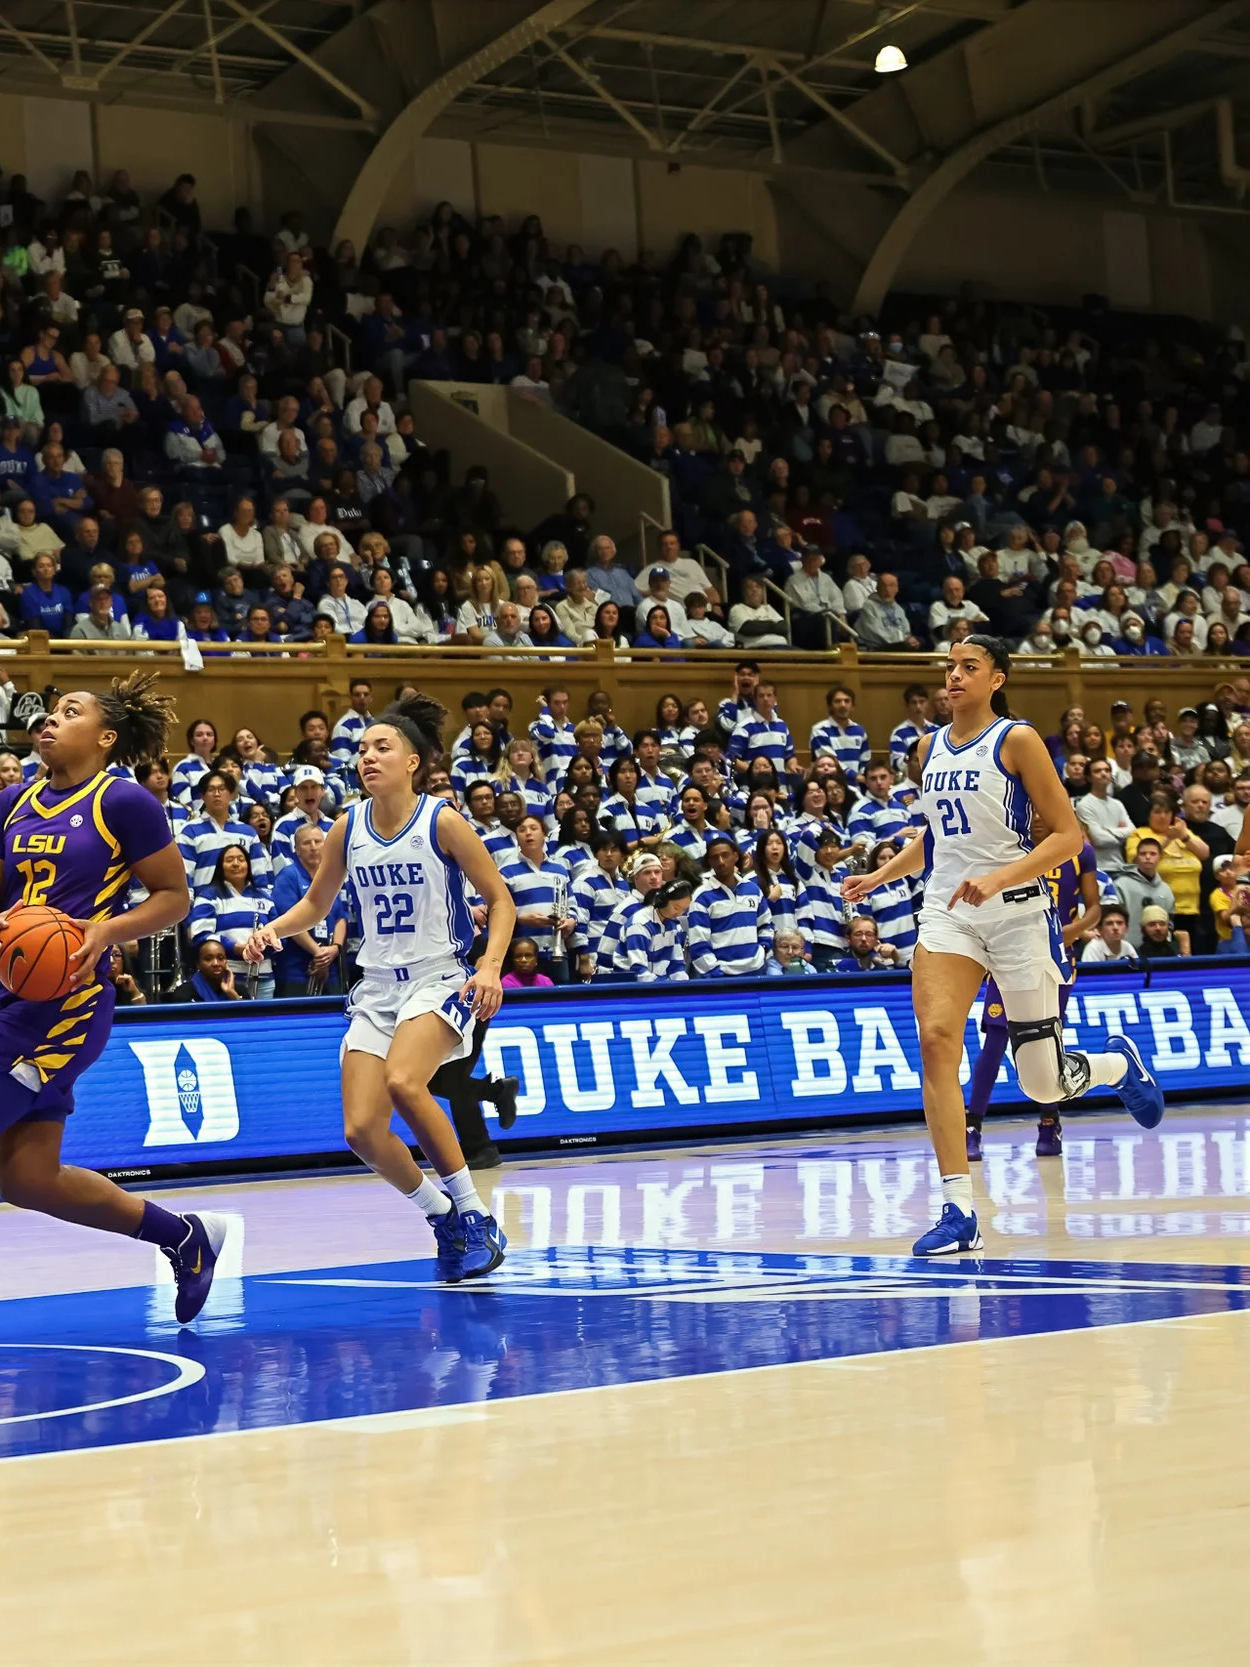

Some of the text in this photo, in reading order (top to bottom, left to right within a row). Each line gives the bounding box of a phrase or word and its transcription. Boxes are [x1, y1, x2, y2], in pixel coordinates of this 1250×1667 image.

[925, 770, 980, 793] DUKE
[937, 798, 972, 836] 21
[12, 834, 68, 854] LSU
[16, 858, 59, 907] 12
[356, 863, 424, 888] DUKE
[374, 893, 416, 935] 22
[481, 1014, 761, 1118] DUKE
[560, 1137, 597, 1145] DAKTRONICS
[107, 1169, 151, 1178] DAKTRONICS
